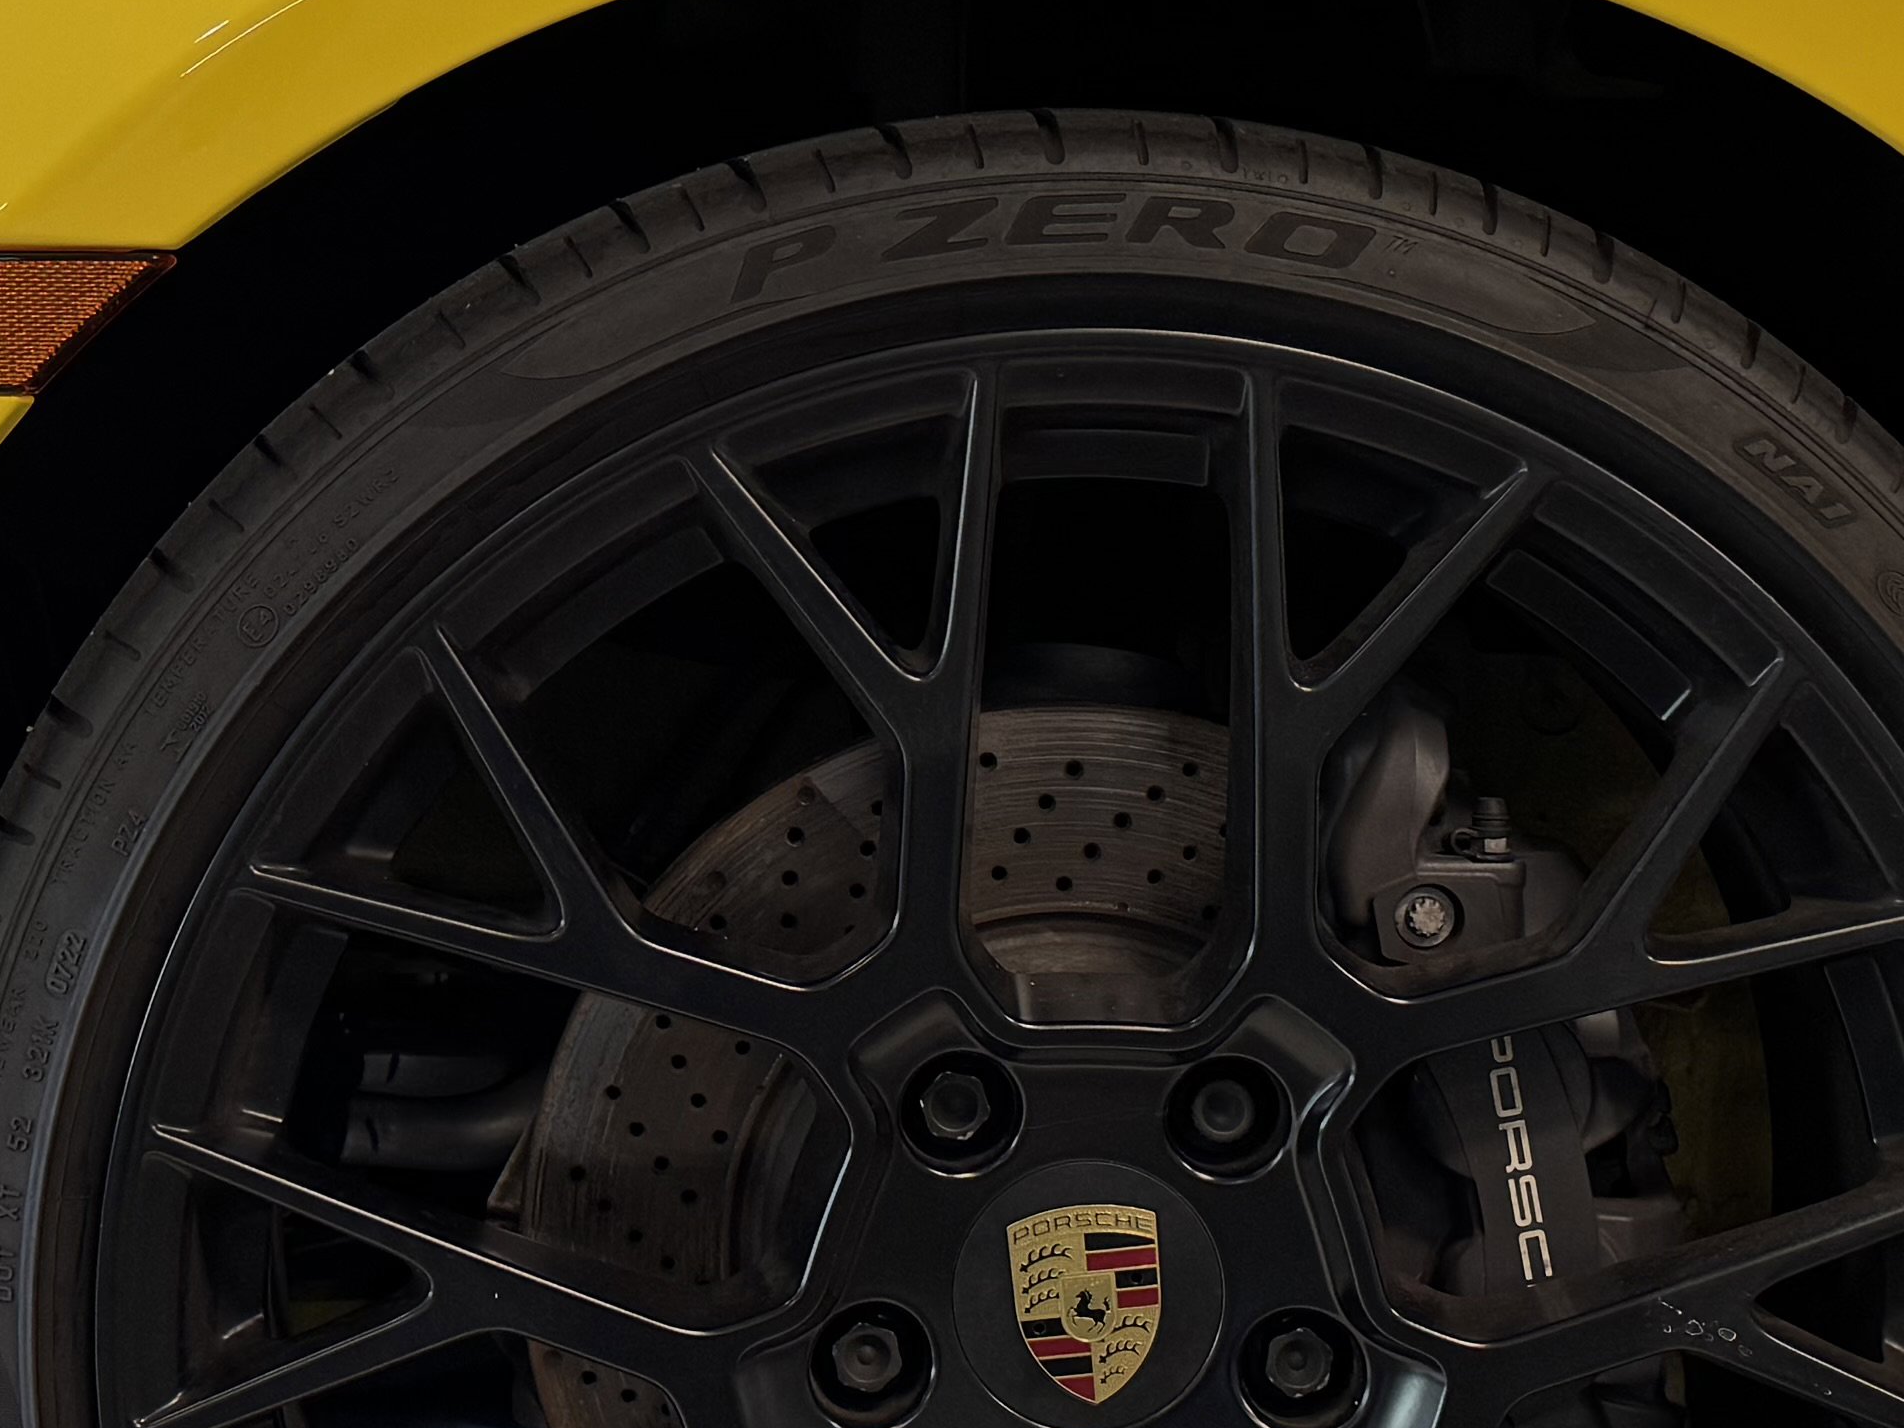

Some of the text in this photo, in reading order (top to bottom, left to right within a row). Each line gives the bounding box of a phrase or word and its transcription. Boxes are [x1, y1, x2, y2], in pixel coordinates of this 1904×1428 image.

[729, 225, 834, 303] P
[884, 193, 1377, 270] ZERO
[110, 810, 148, 858] PZ4
[5, 1114, 35, 1154] 52
[21, 1017, 60, 1084] 321K
[46, 929, 90, 998] 0722
[1013, 1211, 1153, 1245] PORSCHE
